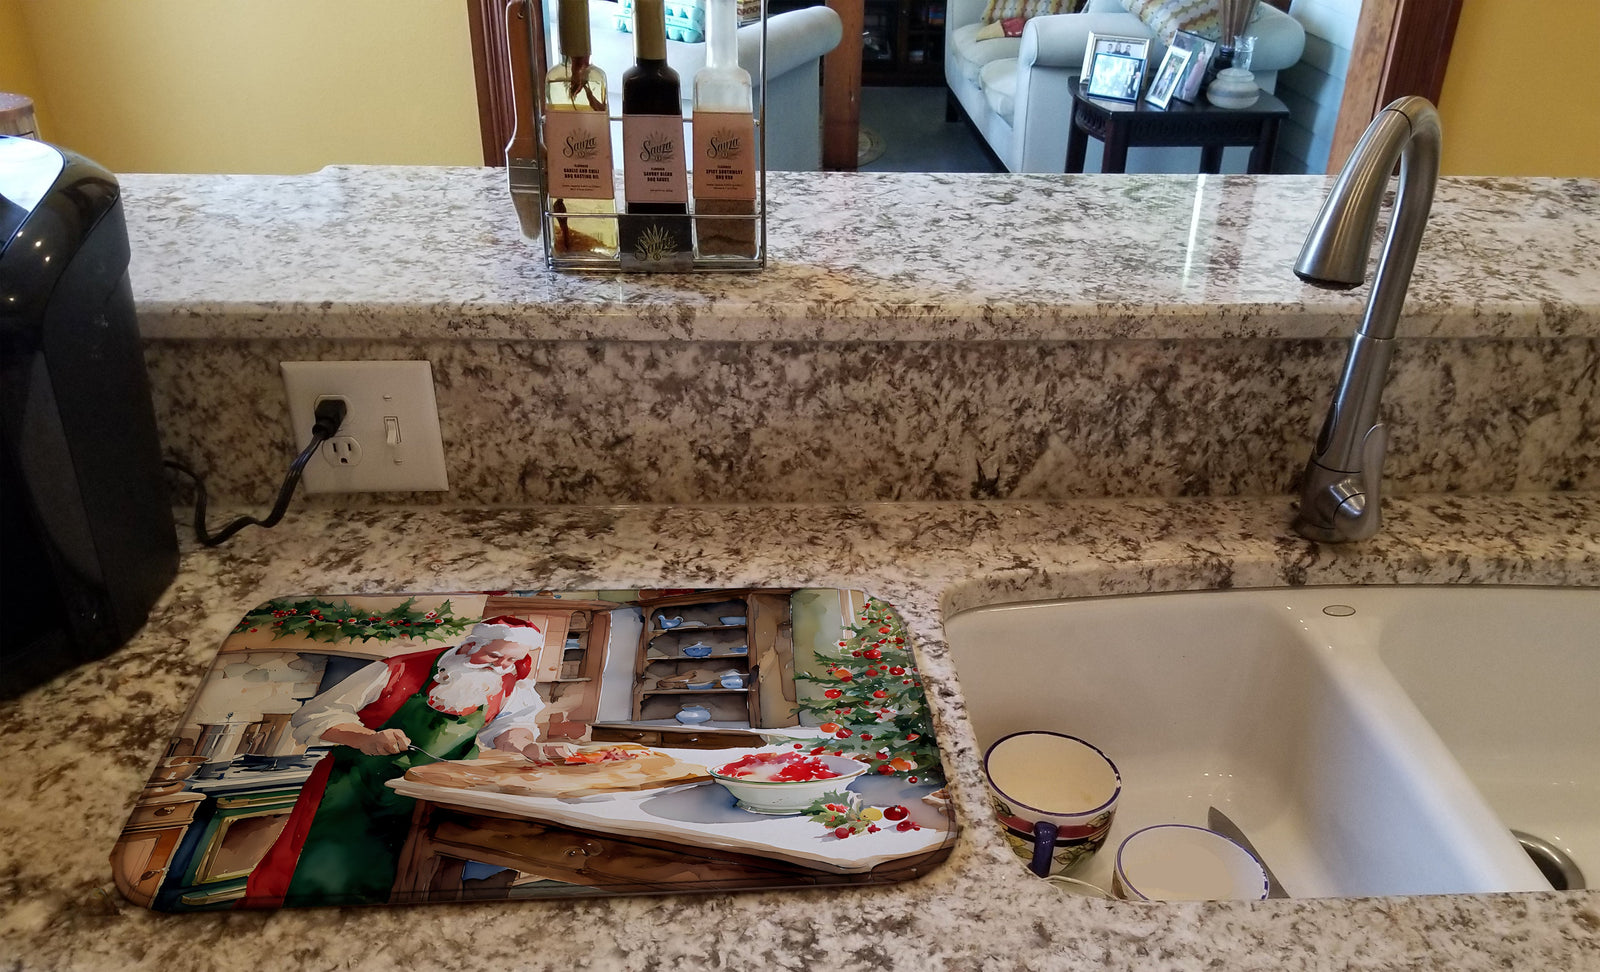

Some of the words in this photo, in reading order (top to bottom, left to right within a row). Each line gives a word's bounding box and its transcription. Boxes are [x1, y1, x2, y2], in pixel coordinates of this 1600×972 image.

[563, 136, 597, 158] Sauza
[640, 140, 674, 162] Sauza
[707, 137, 740, 159] Sauza
